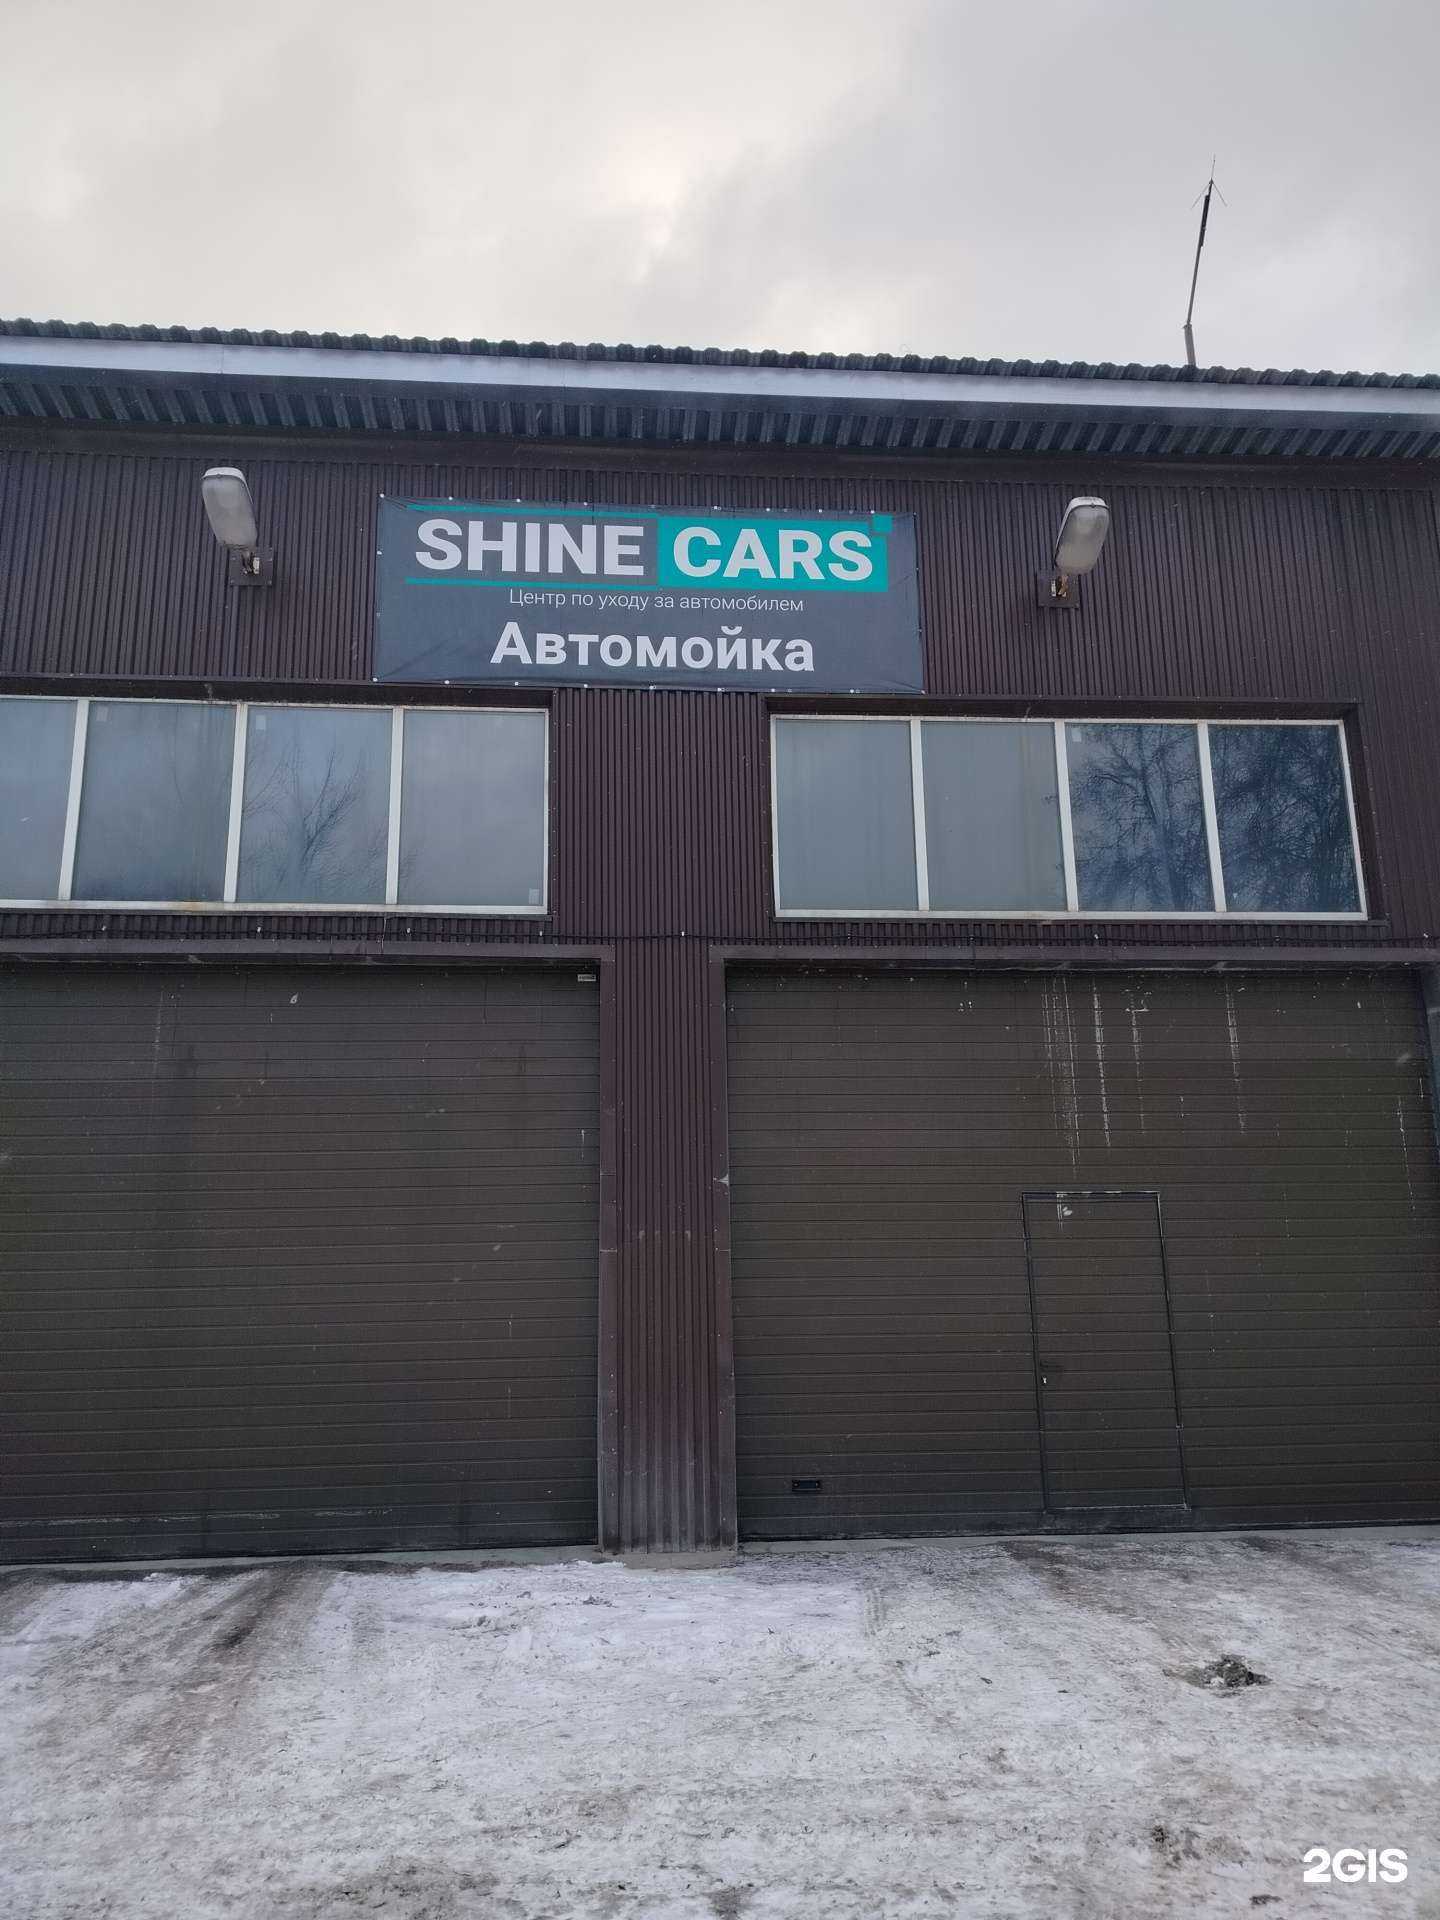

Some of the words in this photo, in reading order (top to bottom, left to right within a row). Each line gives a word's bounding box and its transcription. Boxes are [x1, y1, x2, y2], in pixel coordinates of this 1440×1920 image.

[415, 518, 645, 576] SHINE
[673, 526, 872, 581] CARS
[509, 588, 566, 608] Центр
[571, 594, 594, 606] по
[598, 595, 649, 612] уходу
[654, 596, 674, 609] за
[679, 594, 804, 612] автомобилем
[490, 621, 815, 672] Автомойка
